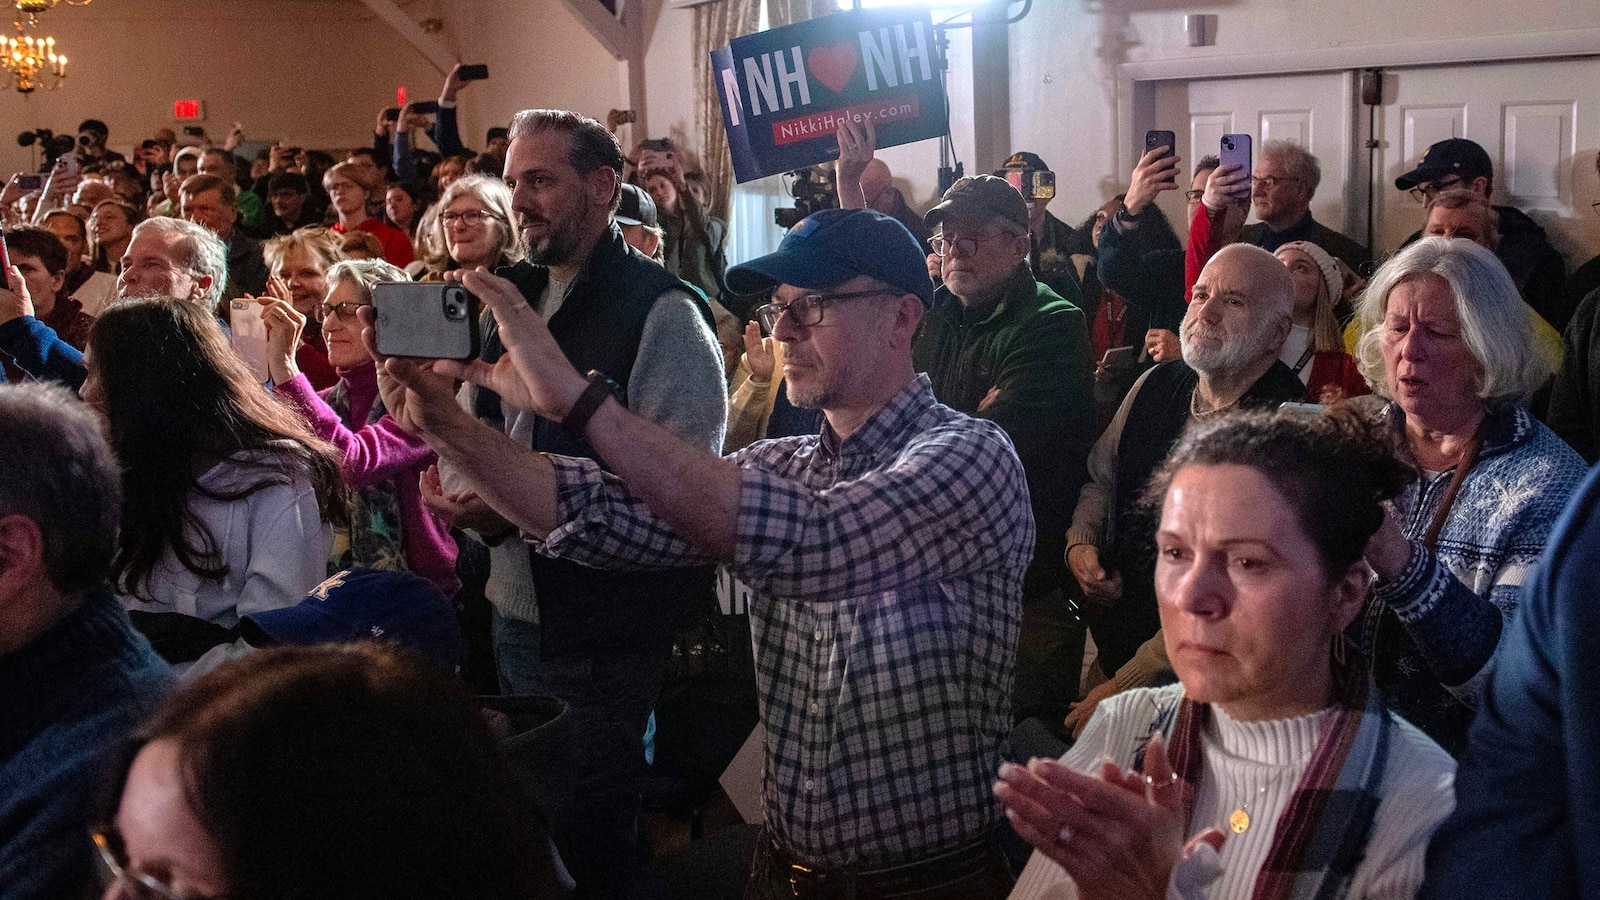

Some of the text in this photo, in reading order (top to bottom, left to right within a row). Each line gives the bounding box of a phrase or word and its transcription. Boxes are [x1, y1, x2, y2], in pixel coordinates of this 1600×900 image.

[743, 20, 932, 117] NH NH
[781, 104, 912, 139] NikkiHaley.com
